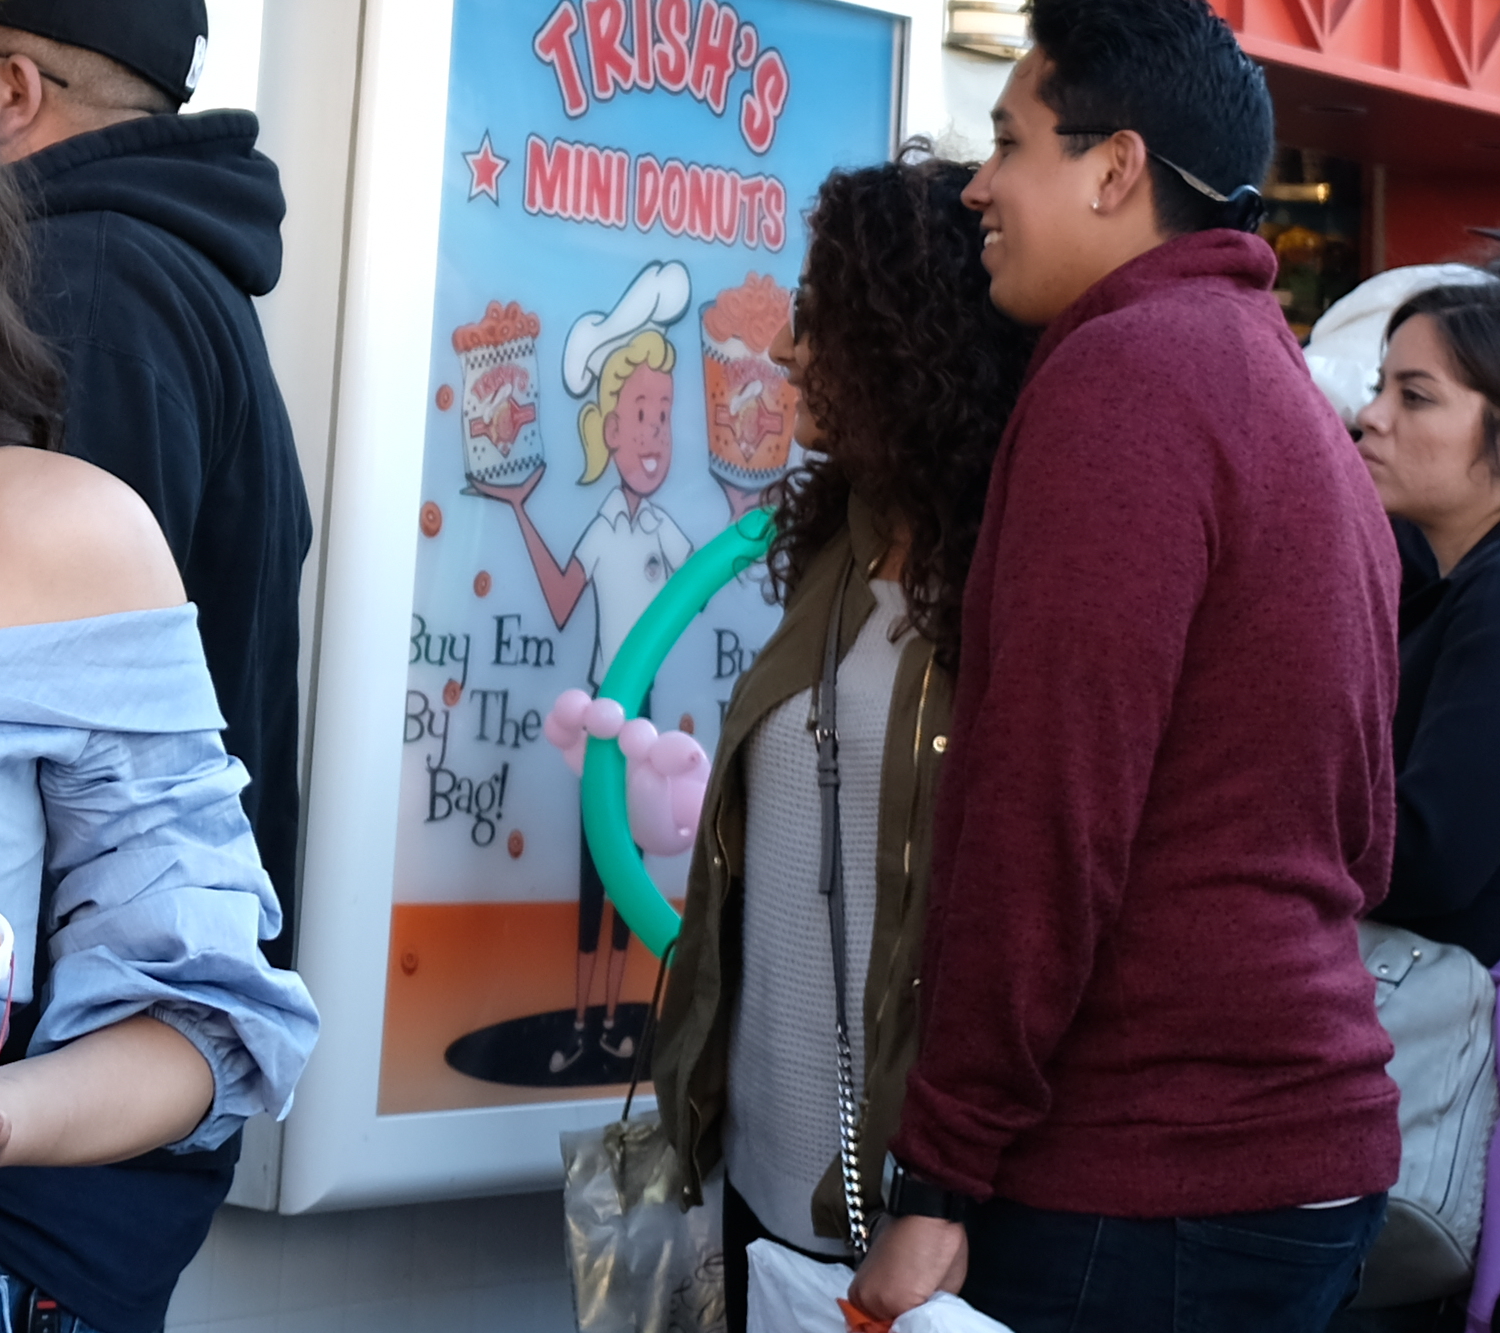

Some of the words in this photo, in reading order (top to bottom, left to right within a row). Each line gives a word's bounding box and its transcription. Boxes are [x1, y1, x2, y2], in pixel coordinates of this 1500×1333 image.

[523, 132, 630, 232] MINI
[634, 151, 787, 253] DONUTS
[490, 613, 557, 668] Em
[403, 689, 451, 771] By
[469, 689, 542, 750] The
[423, 762, 511, 848] Bag!
